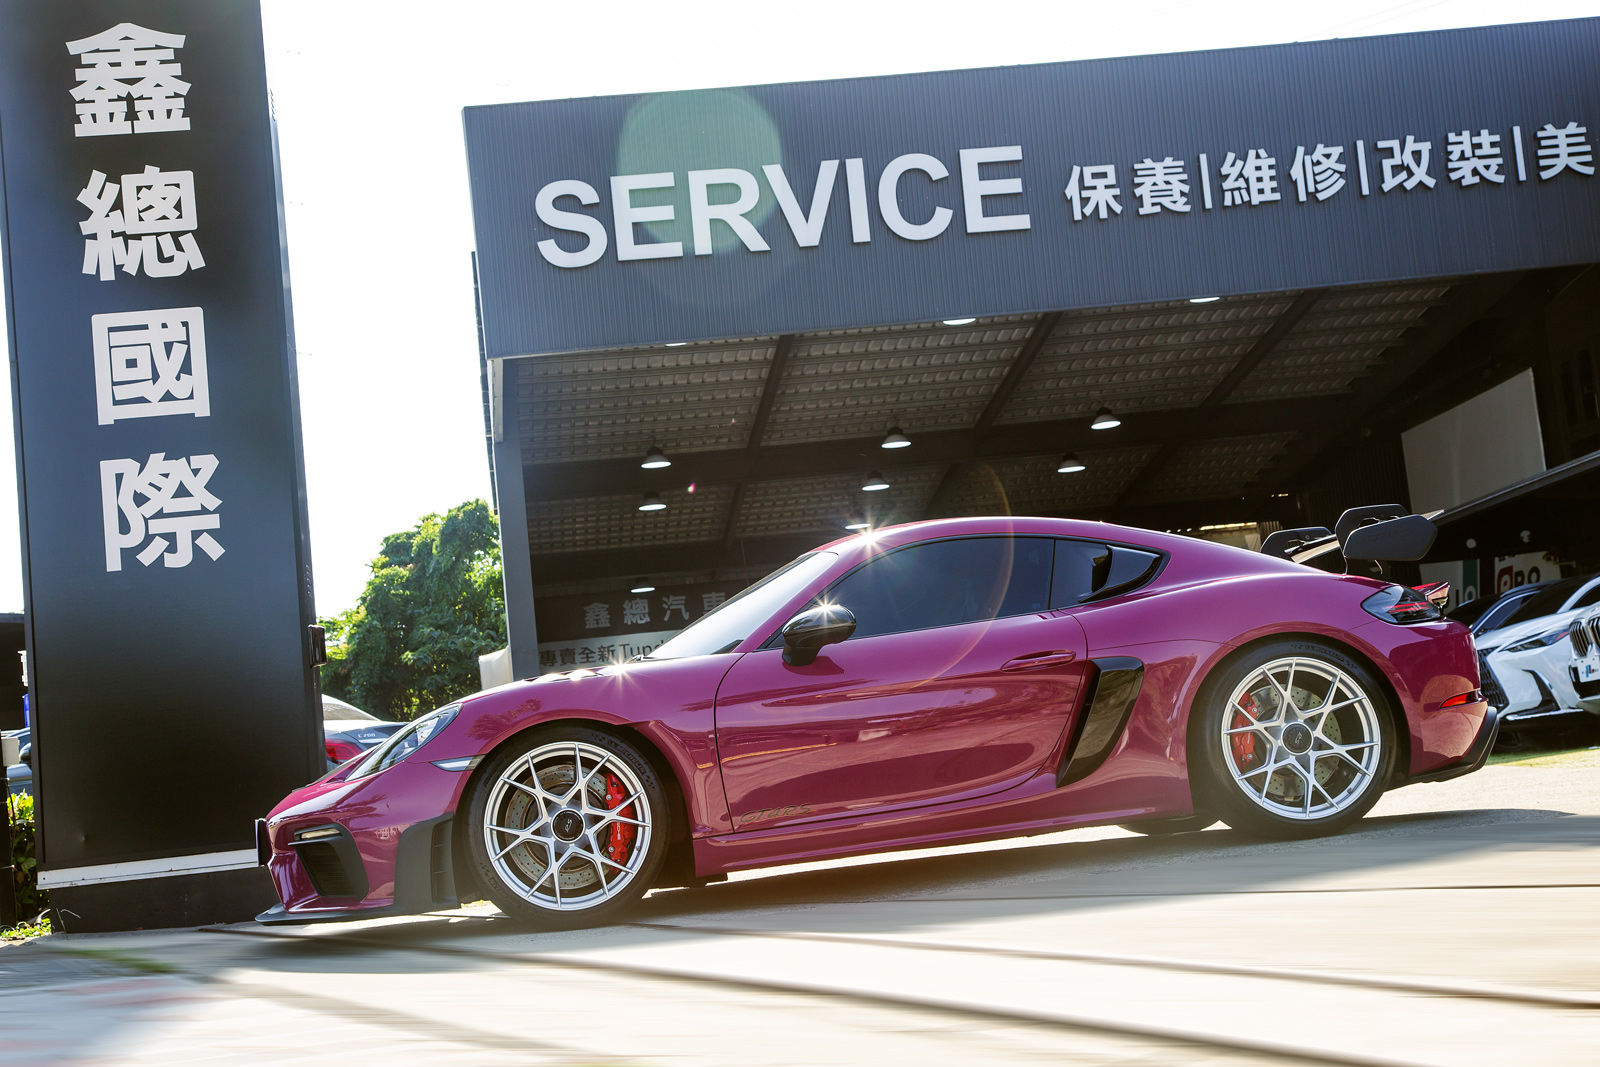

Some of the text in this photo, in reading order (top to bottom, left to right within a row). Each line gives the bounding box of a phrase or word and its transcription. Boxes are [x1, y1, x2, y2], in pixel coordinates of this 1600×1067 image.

[534, 145, 1032, 269] SERVICE
[66, 22, 226, 572] 鑫總國際
[539, 644, 616, 667] 專賣全新
